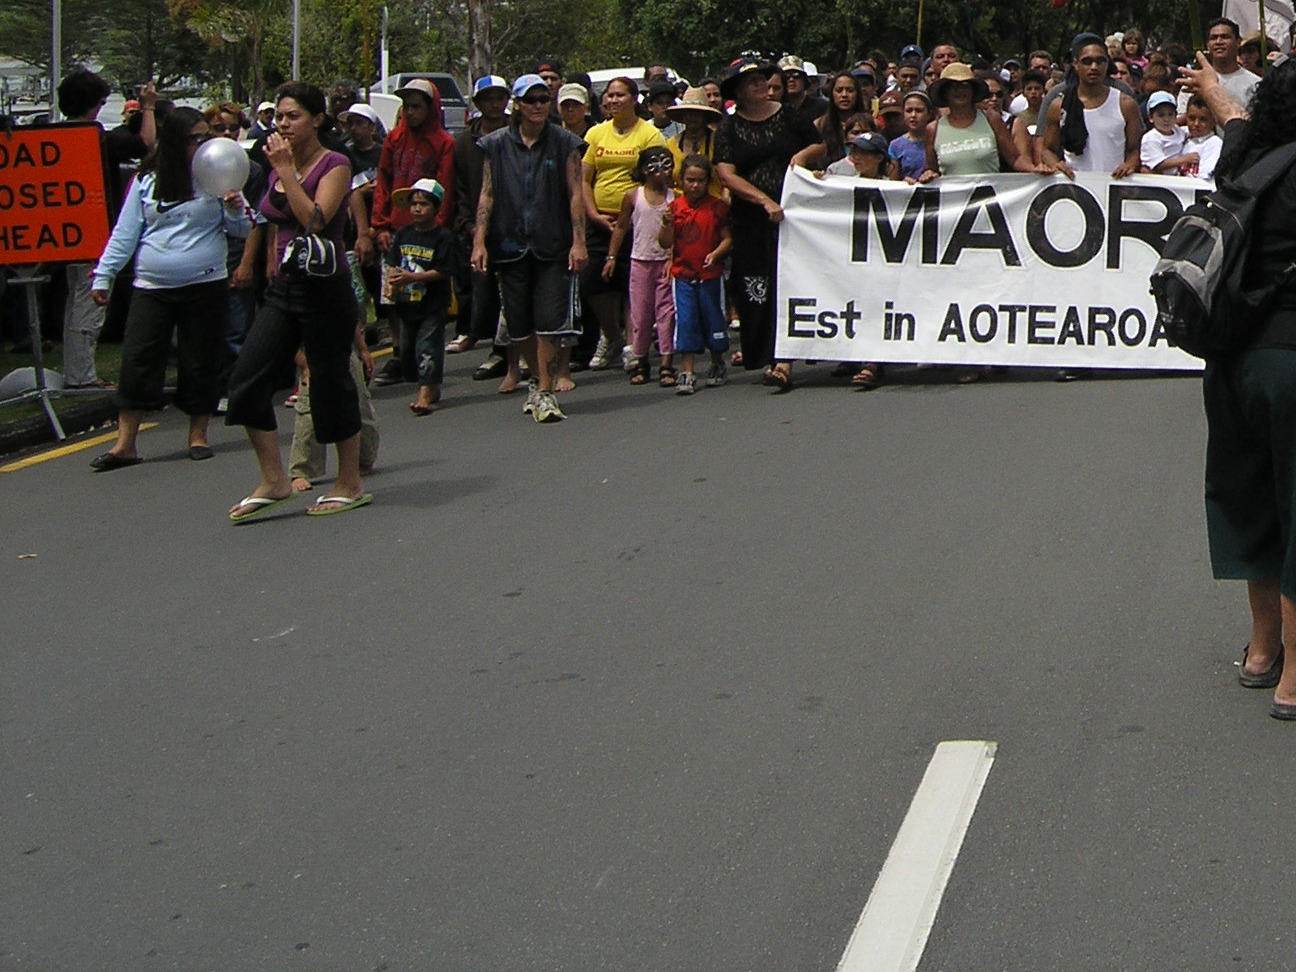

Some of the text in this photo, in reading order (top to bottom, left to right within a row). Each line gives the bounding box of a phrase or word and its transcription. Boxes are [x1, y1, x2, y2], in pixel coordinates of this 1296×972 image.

[850, 183, 1213, 270] MAOR
[787, 297, 862, 339] Est
[883, 301, 915, 341] in
[938, 303, 1178, 347] AOTEAROA
